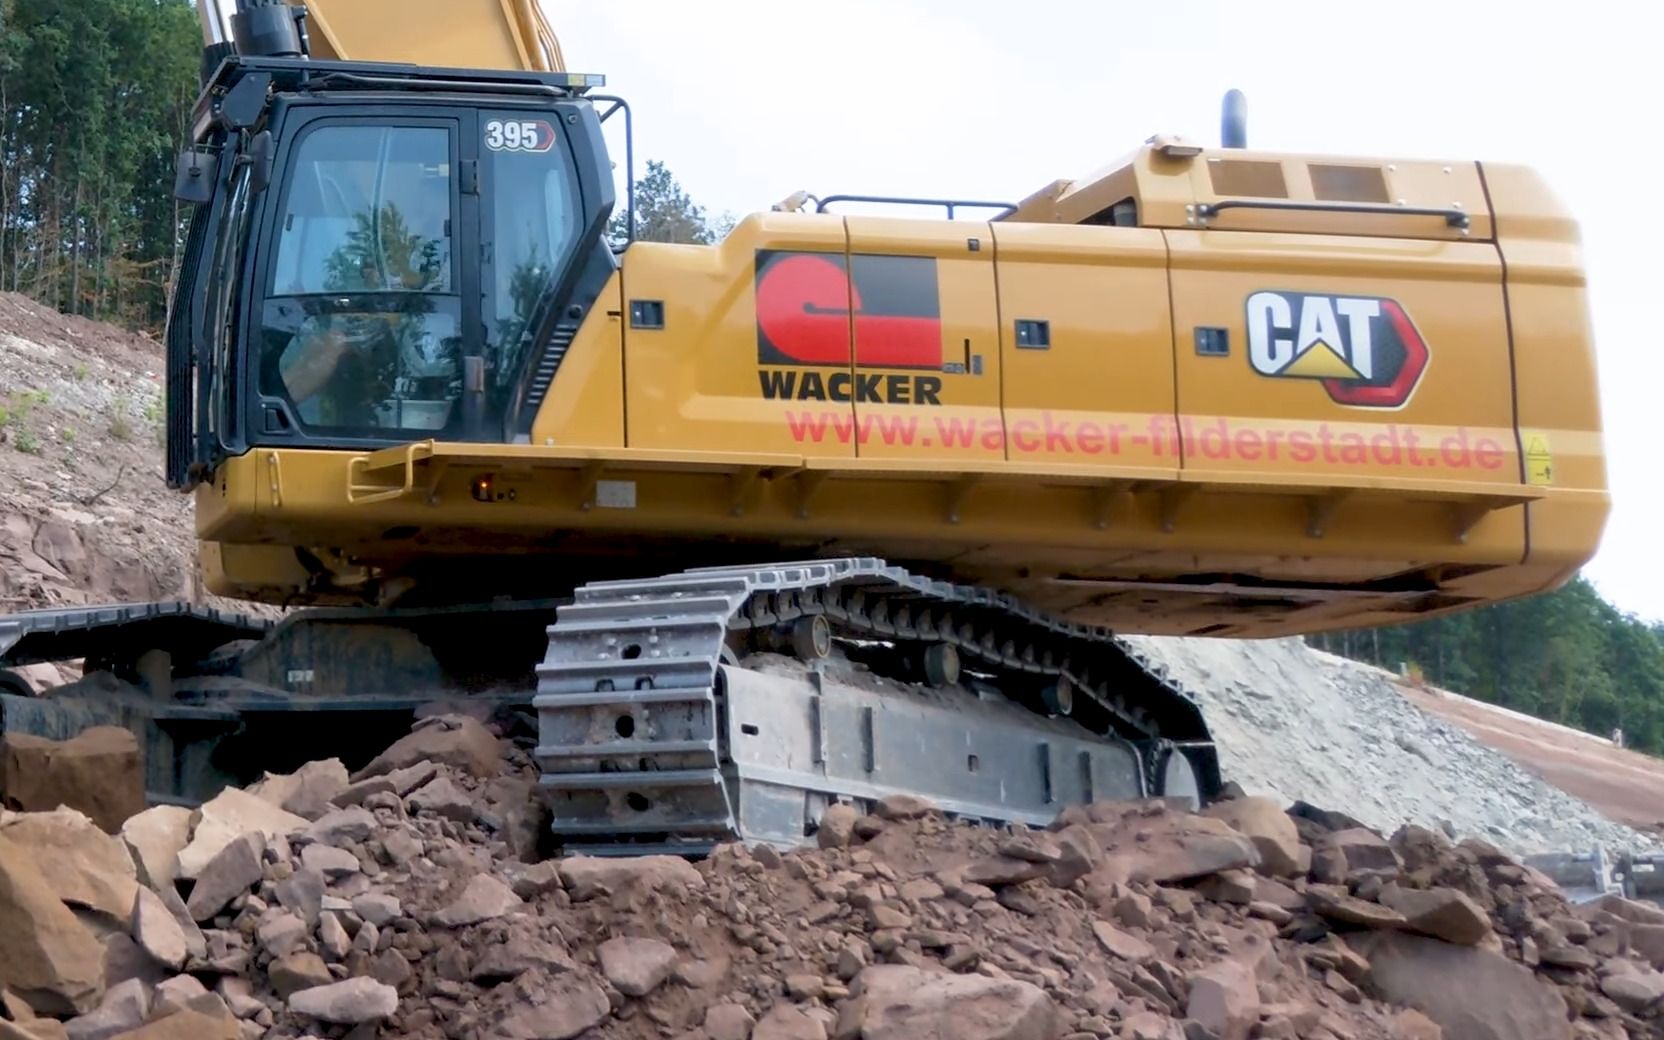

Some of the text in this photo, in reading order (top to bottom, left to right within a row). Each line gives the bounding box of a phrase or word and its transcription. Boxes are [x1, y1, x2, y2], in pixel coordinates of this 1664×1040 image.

[487, 121, 538, 148] 395
[1247, 292, 1380, 379] CAT
[759, 371, 943, 405] WACKER
[786, 409, 1505, 469] www.wacker-filderstadt.de
